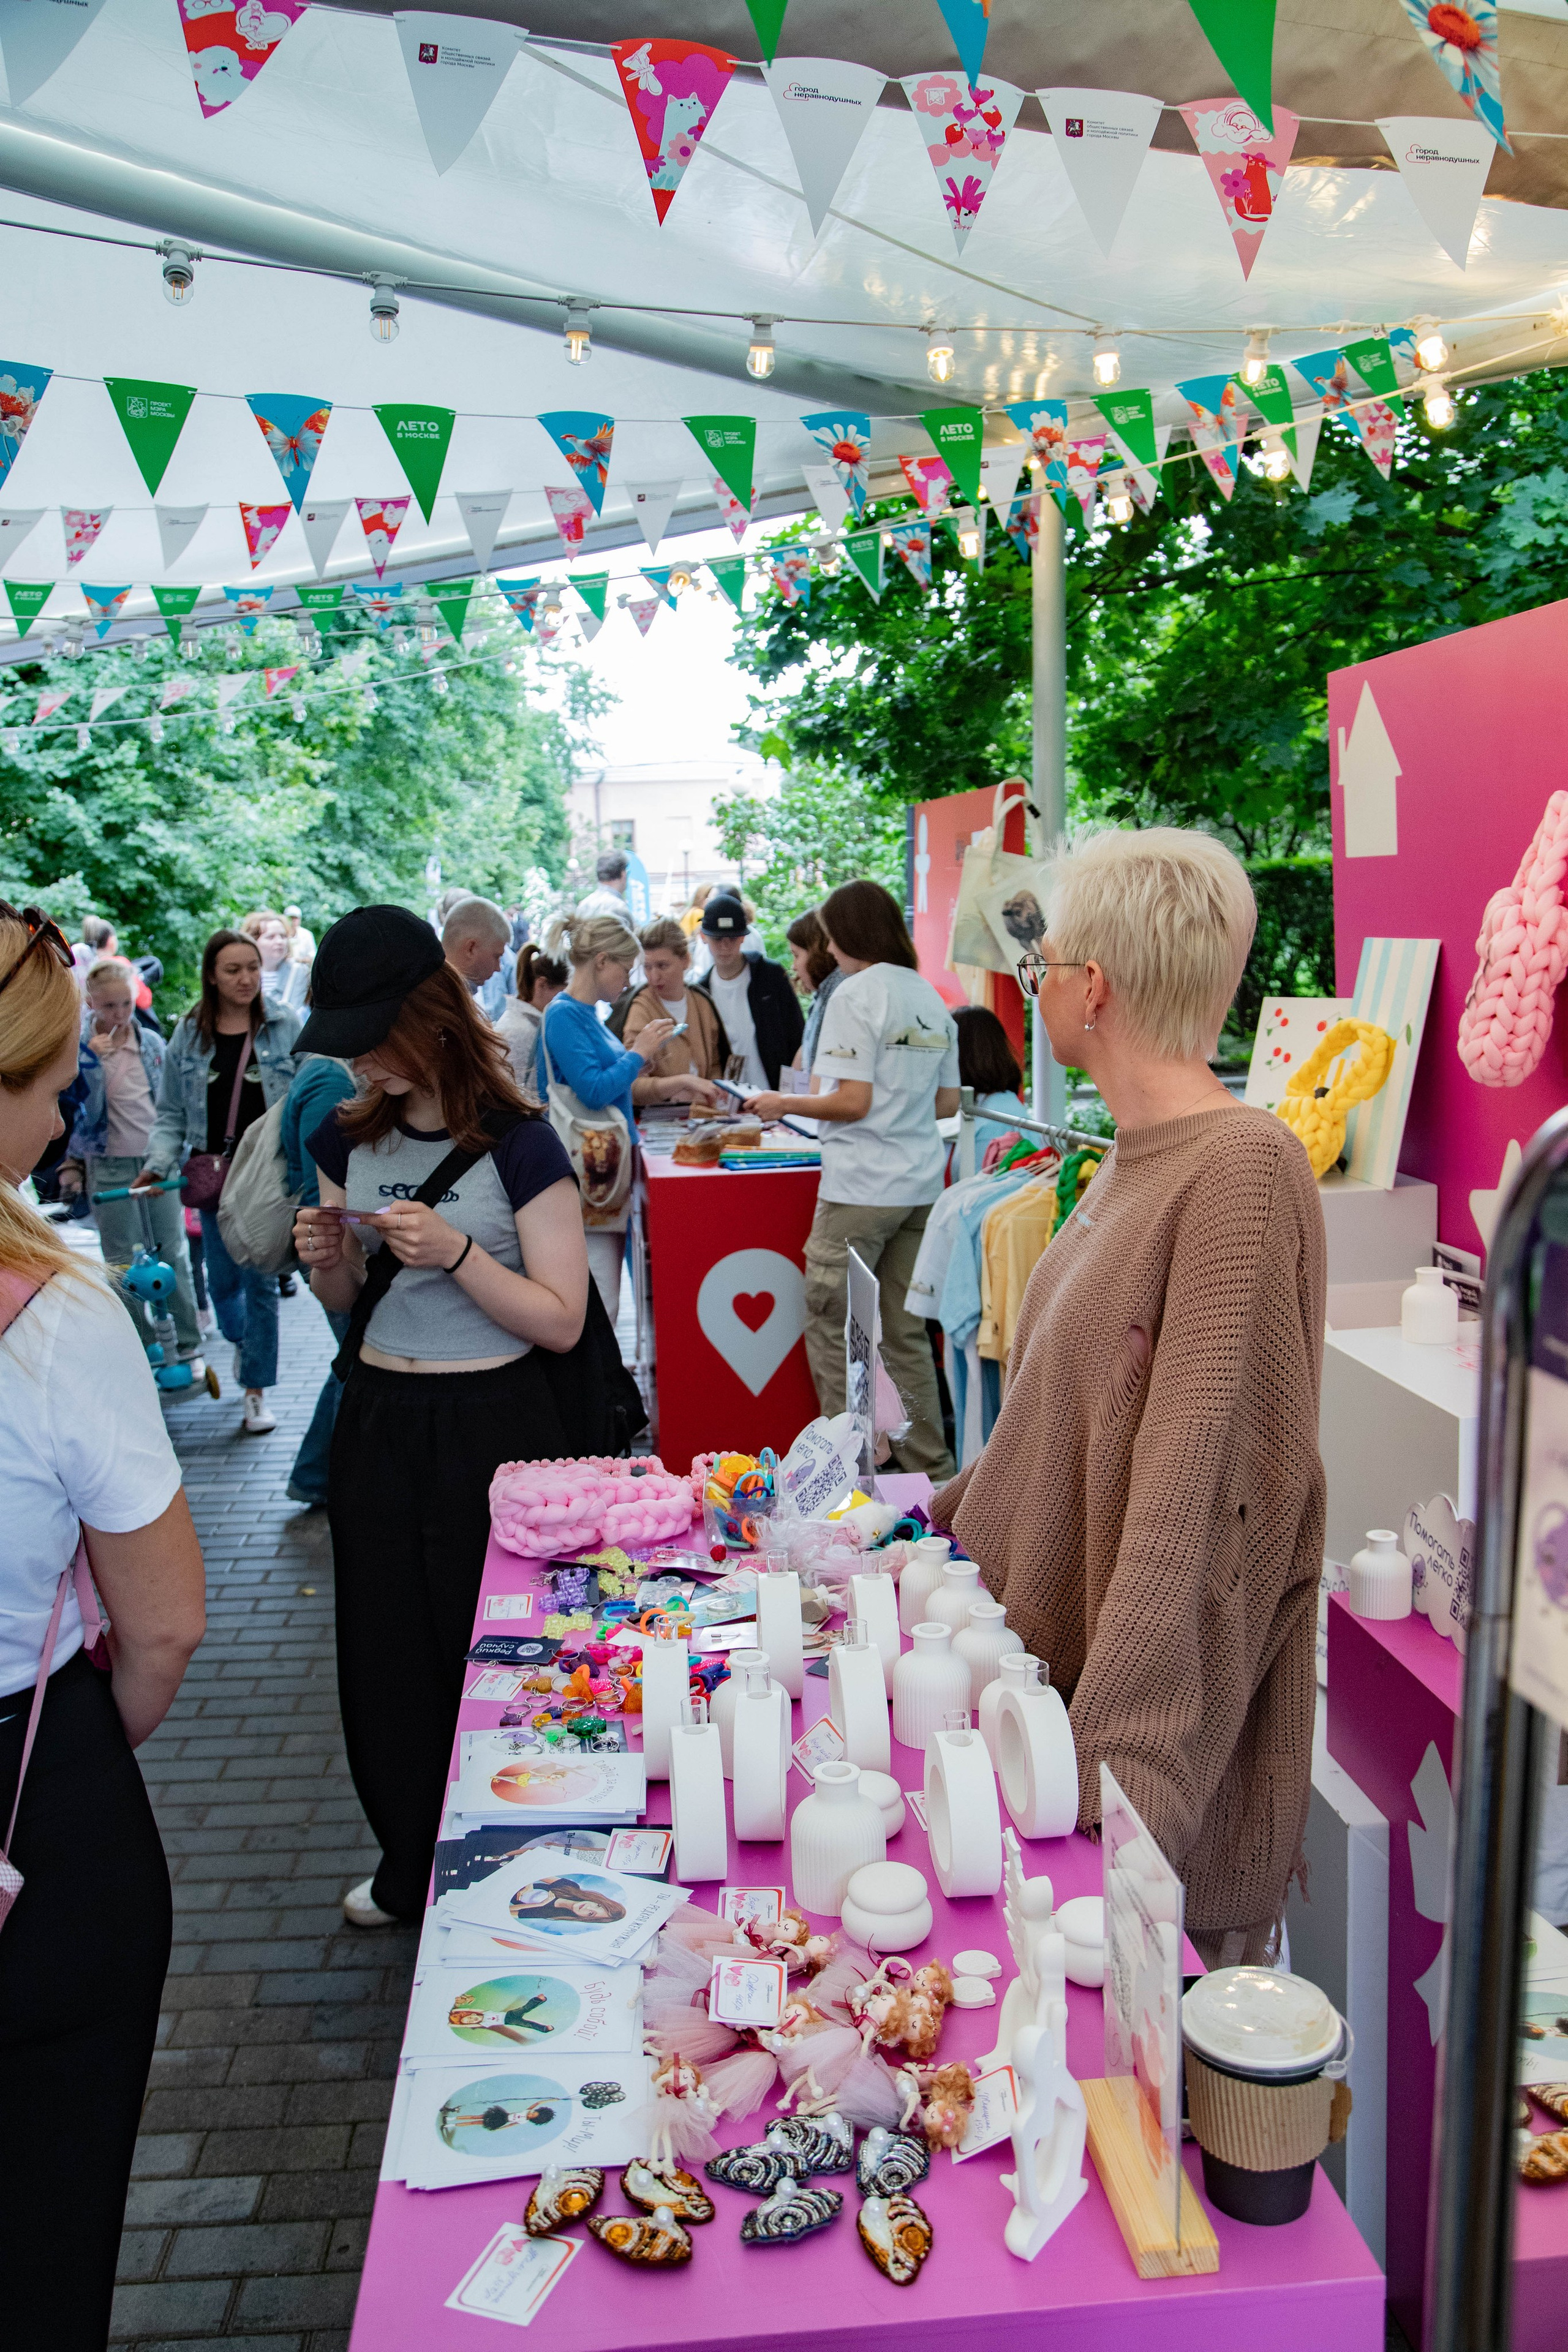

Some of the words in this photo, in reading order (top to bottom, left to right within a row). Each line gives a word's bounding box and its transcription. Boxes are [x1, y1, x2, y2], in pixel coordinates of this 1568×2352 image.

[441, 51, 474, 59] общественных
[794, 92, 862, 105] неравнодушных
[1415, 154, 1480, 164] неравнодушных
[396, 421, 439, 432] ЛЕТО
[940, 423, 973, 435] ЛЕТО
[802, 1424, 834, 1454] Помогать
[793, 1442, 813, 1459] легко
[1410, 1511, 1455, 1570] Помогать
[1427, 1555, 1453, 1587] легко
[593, 1760, 619, 1777] Следуй
[636, 1904, 660, 1922] РЕДКАЯ
[608, 1921, 644, 1948] ЖЕМЧУЖИНА
[579, 1981, 612, 2004] Будь
[573, 2007, 607, 2041] собой!
